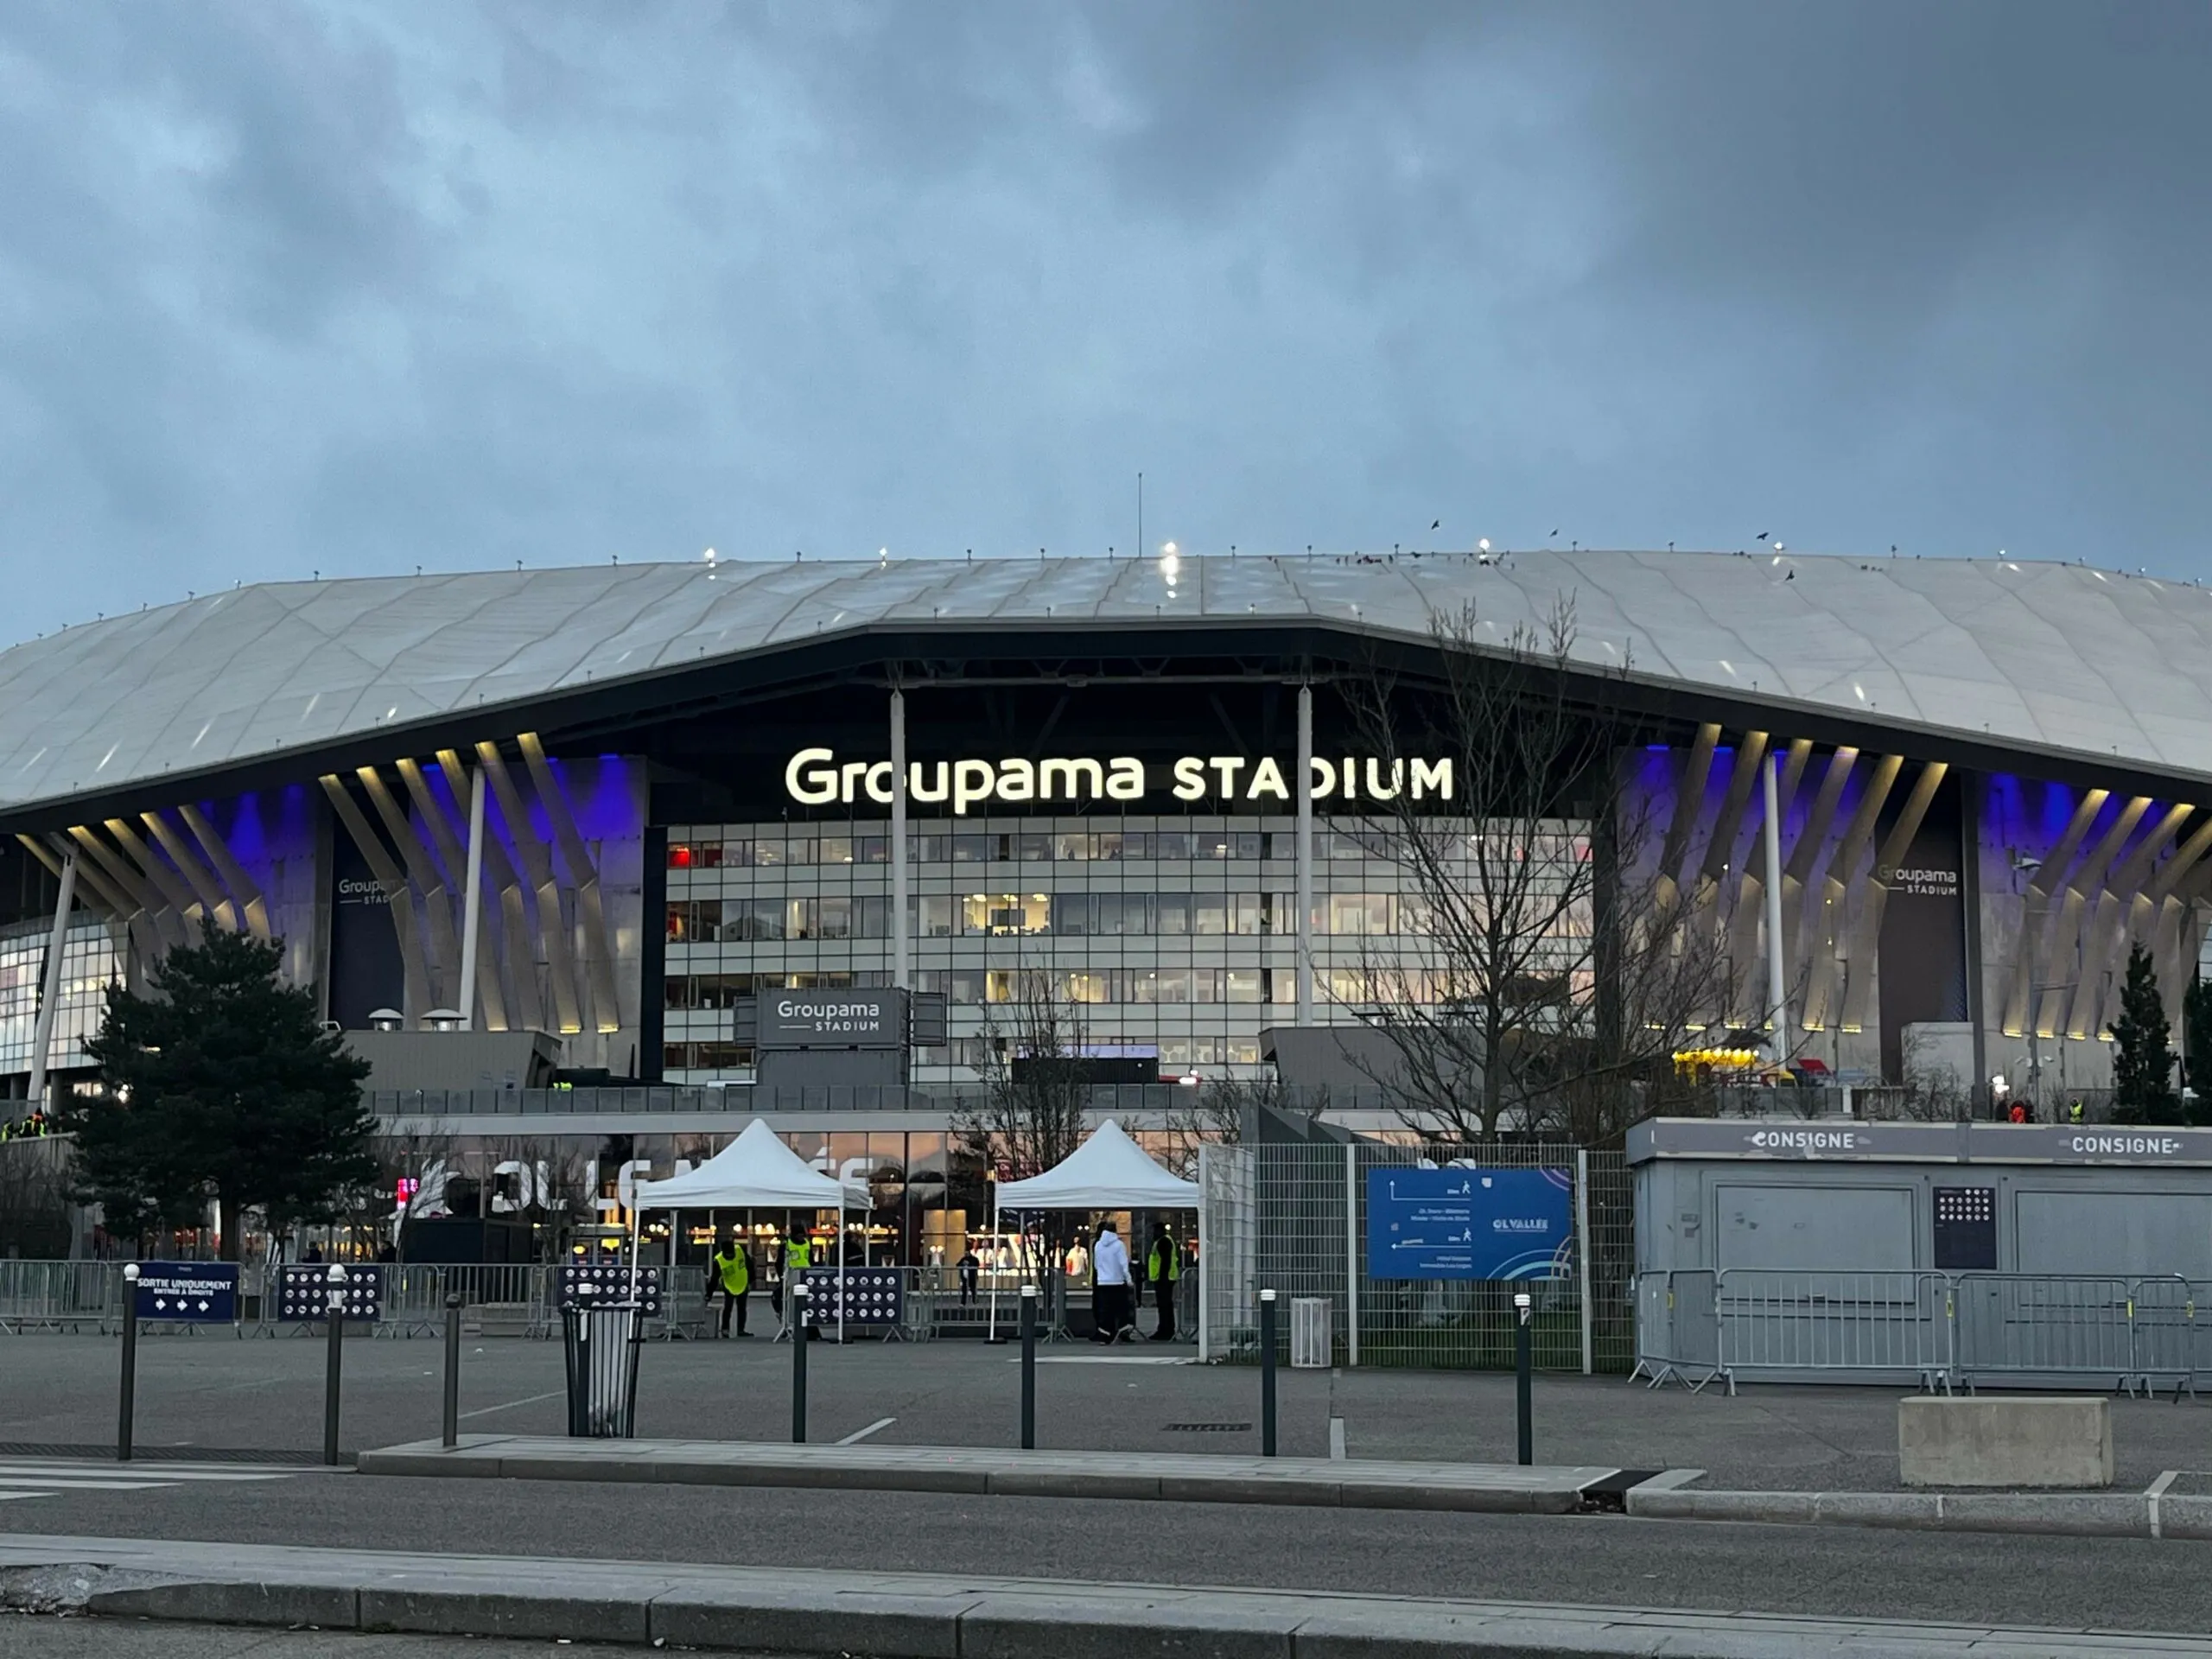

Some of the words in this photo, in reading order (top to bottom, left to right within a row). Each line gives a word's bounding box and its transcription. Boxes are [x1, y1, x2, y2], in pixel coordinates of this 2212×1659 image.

[785, 748, 1144, 815] Groupama
[1172, 757, 1452, 800] STADIUM
[339, 878, 381, 894] Group
[1907, 884, 1957, 895] STADIUM
[364, 895, 390, 905] STAD
[778, 1001, 880, 1020] Groupama
[815, 1021, 880, 1031] STADIUM
[1751, 1131, 1854, 1148] CONSIGNE
[2072, 1136, 2173, 1154] CONSIGNE
[137, 1278, 169, 1288] SORTIE
[171, 1280, 232, 1290] UNIQUEMENT
